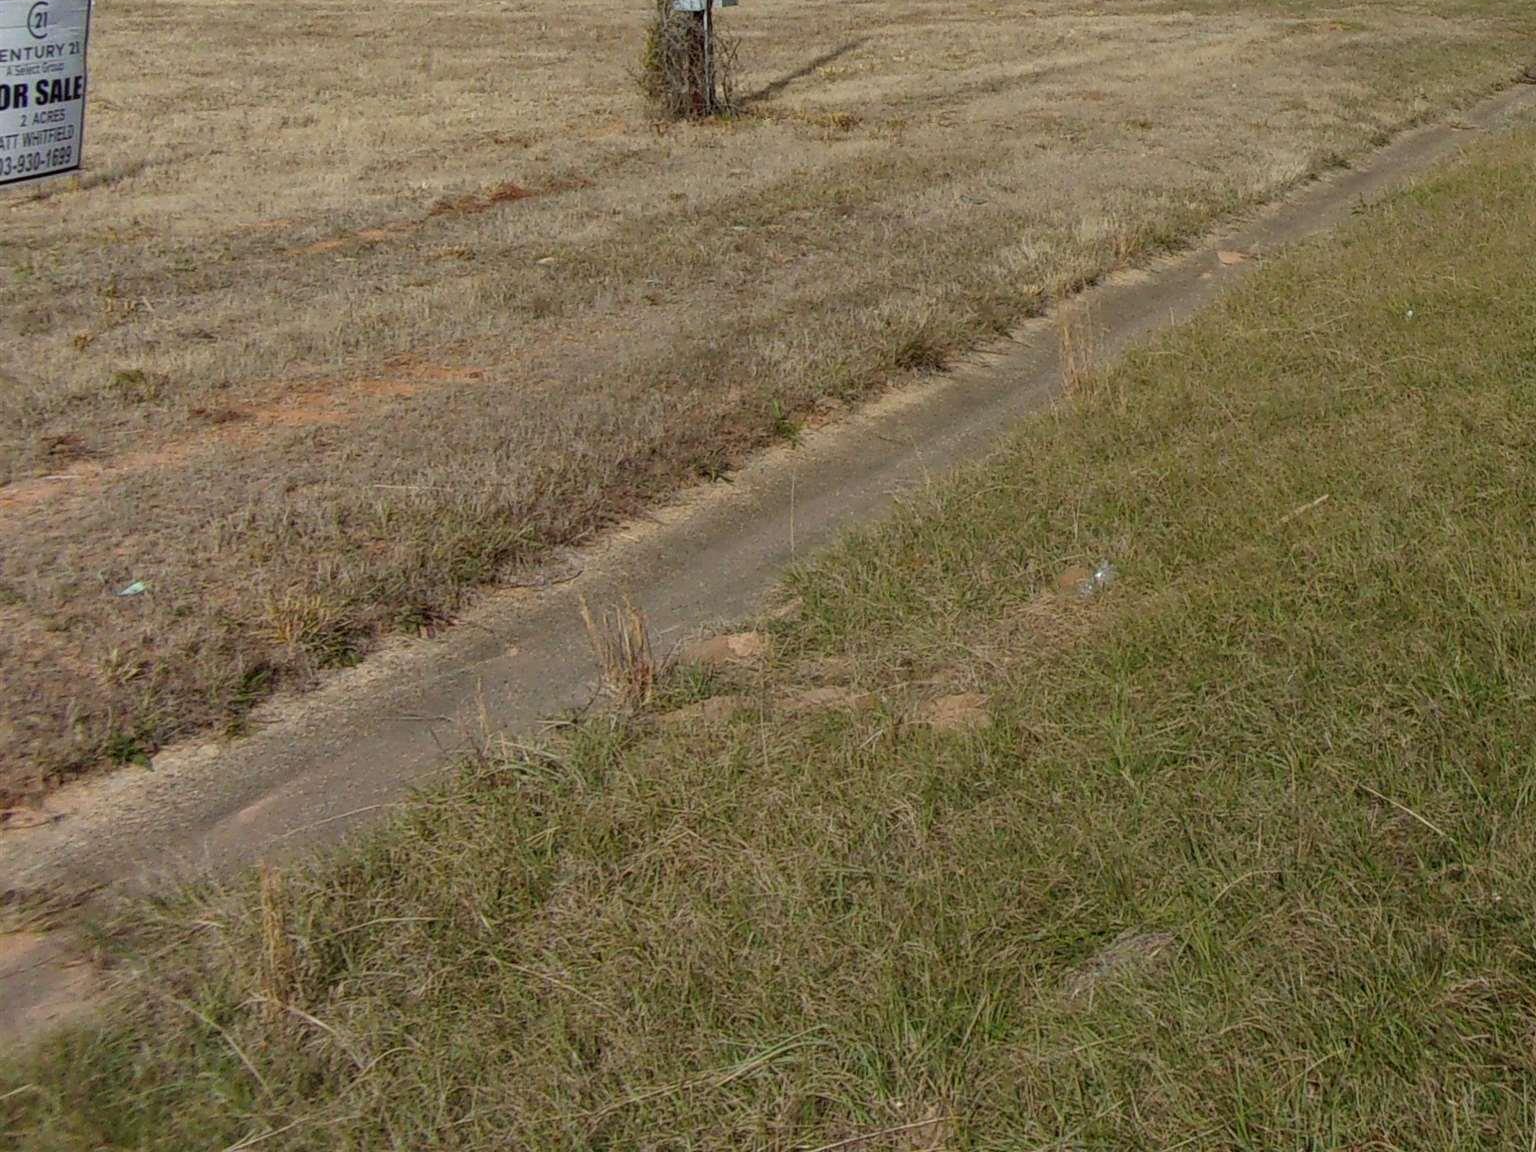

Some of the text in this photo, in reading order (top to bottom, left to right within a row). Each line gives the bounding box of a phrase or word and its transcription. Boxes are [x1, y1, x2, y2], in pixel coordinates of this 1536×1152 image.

[0, 41, 80, 62] ENTURY 21
[0, 76, 83, 111] OR SALE
[20, 108, 65, 128] 2 ACRES
[0, 124, 74, 151] ATT WHITFIELD
